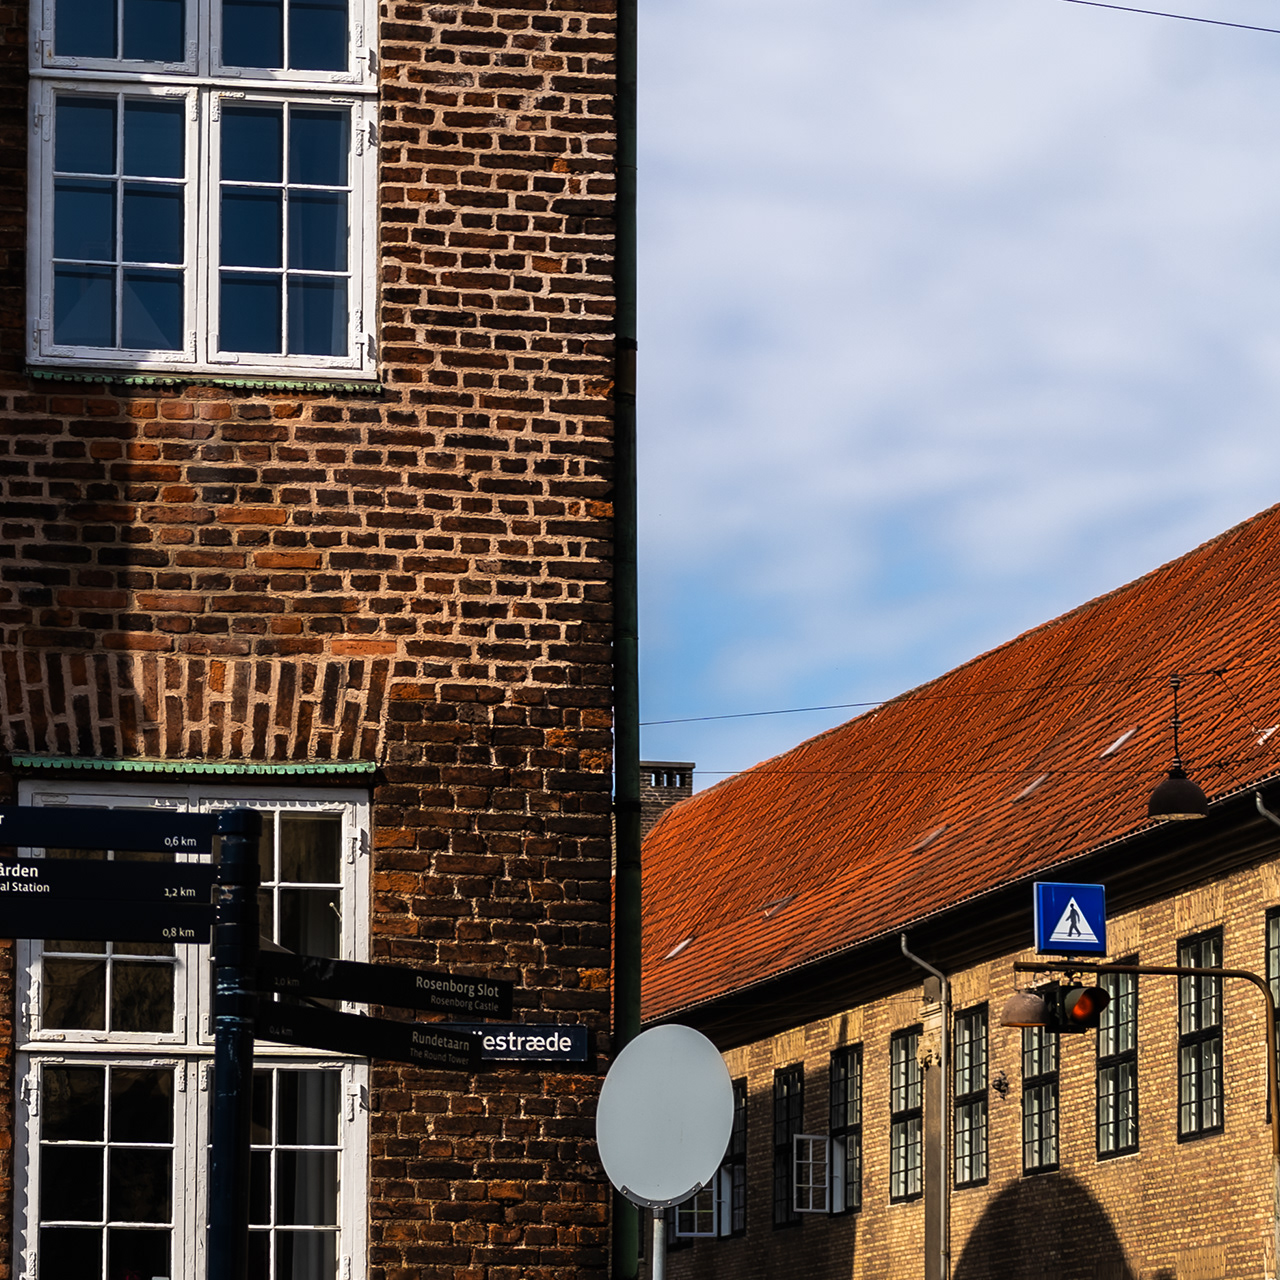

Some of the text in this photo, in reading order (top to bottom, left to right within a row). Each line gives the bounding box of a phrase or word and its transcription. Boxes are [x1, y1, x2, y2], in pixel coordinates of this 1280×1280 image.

[165, 836, 197, 847] 0,6 km
[12, 882, 50, 893] Station
[164, 887, 196, 898] 1,2 km
[163, 927, 195, 938] 0,8 km
[288, 977, 299, 987] km
[416, 976, 499, 997] Rosenborg Slot
[431, 995, 499, 1012] Rosenborg Castle
[281, 1026, 293, 1036] km
[412, 1031, 470, 1050] Rundetaarn
[410, 1047, 469, 1065] The Round Tower
